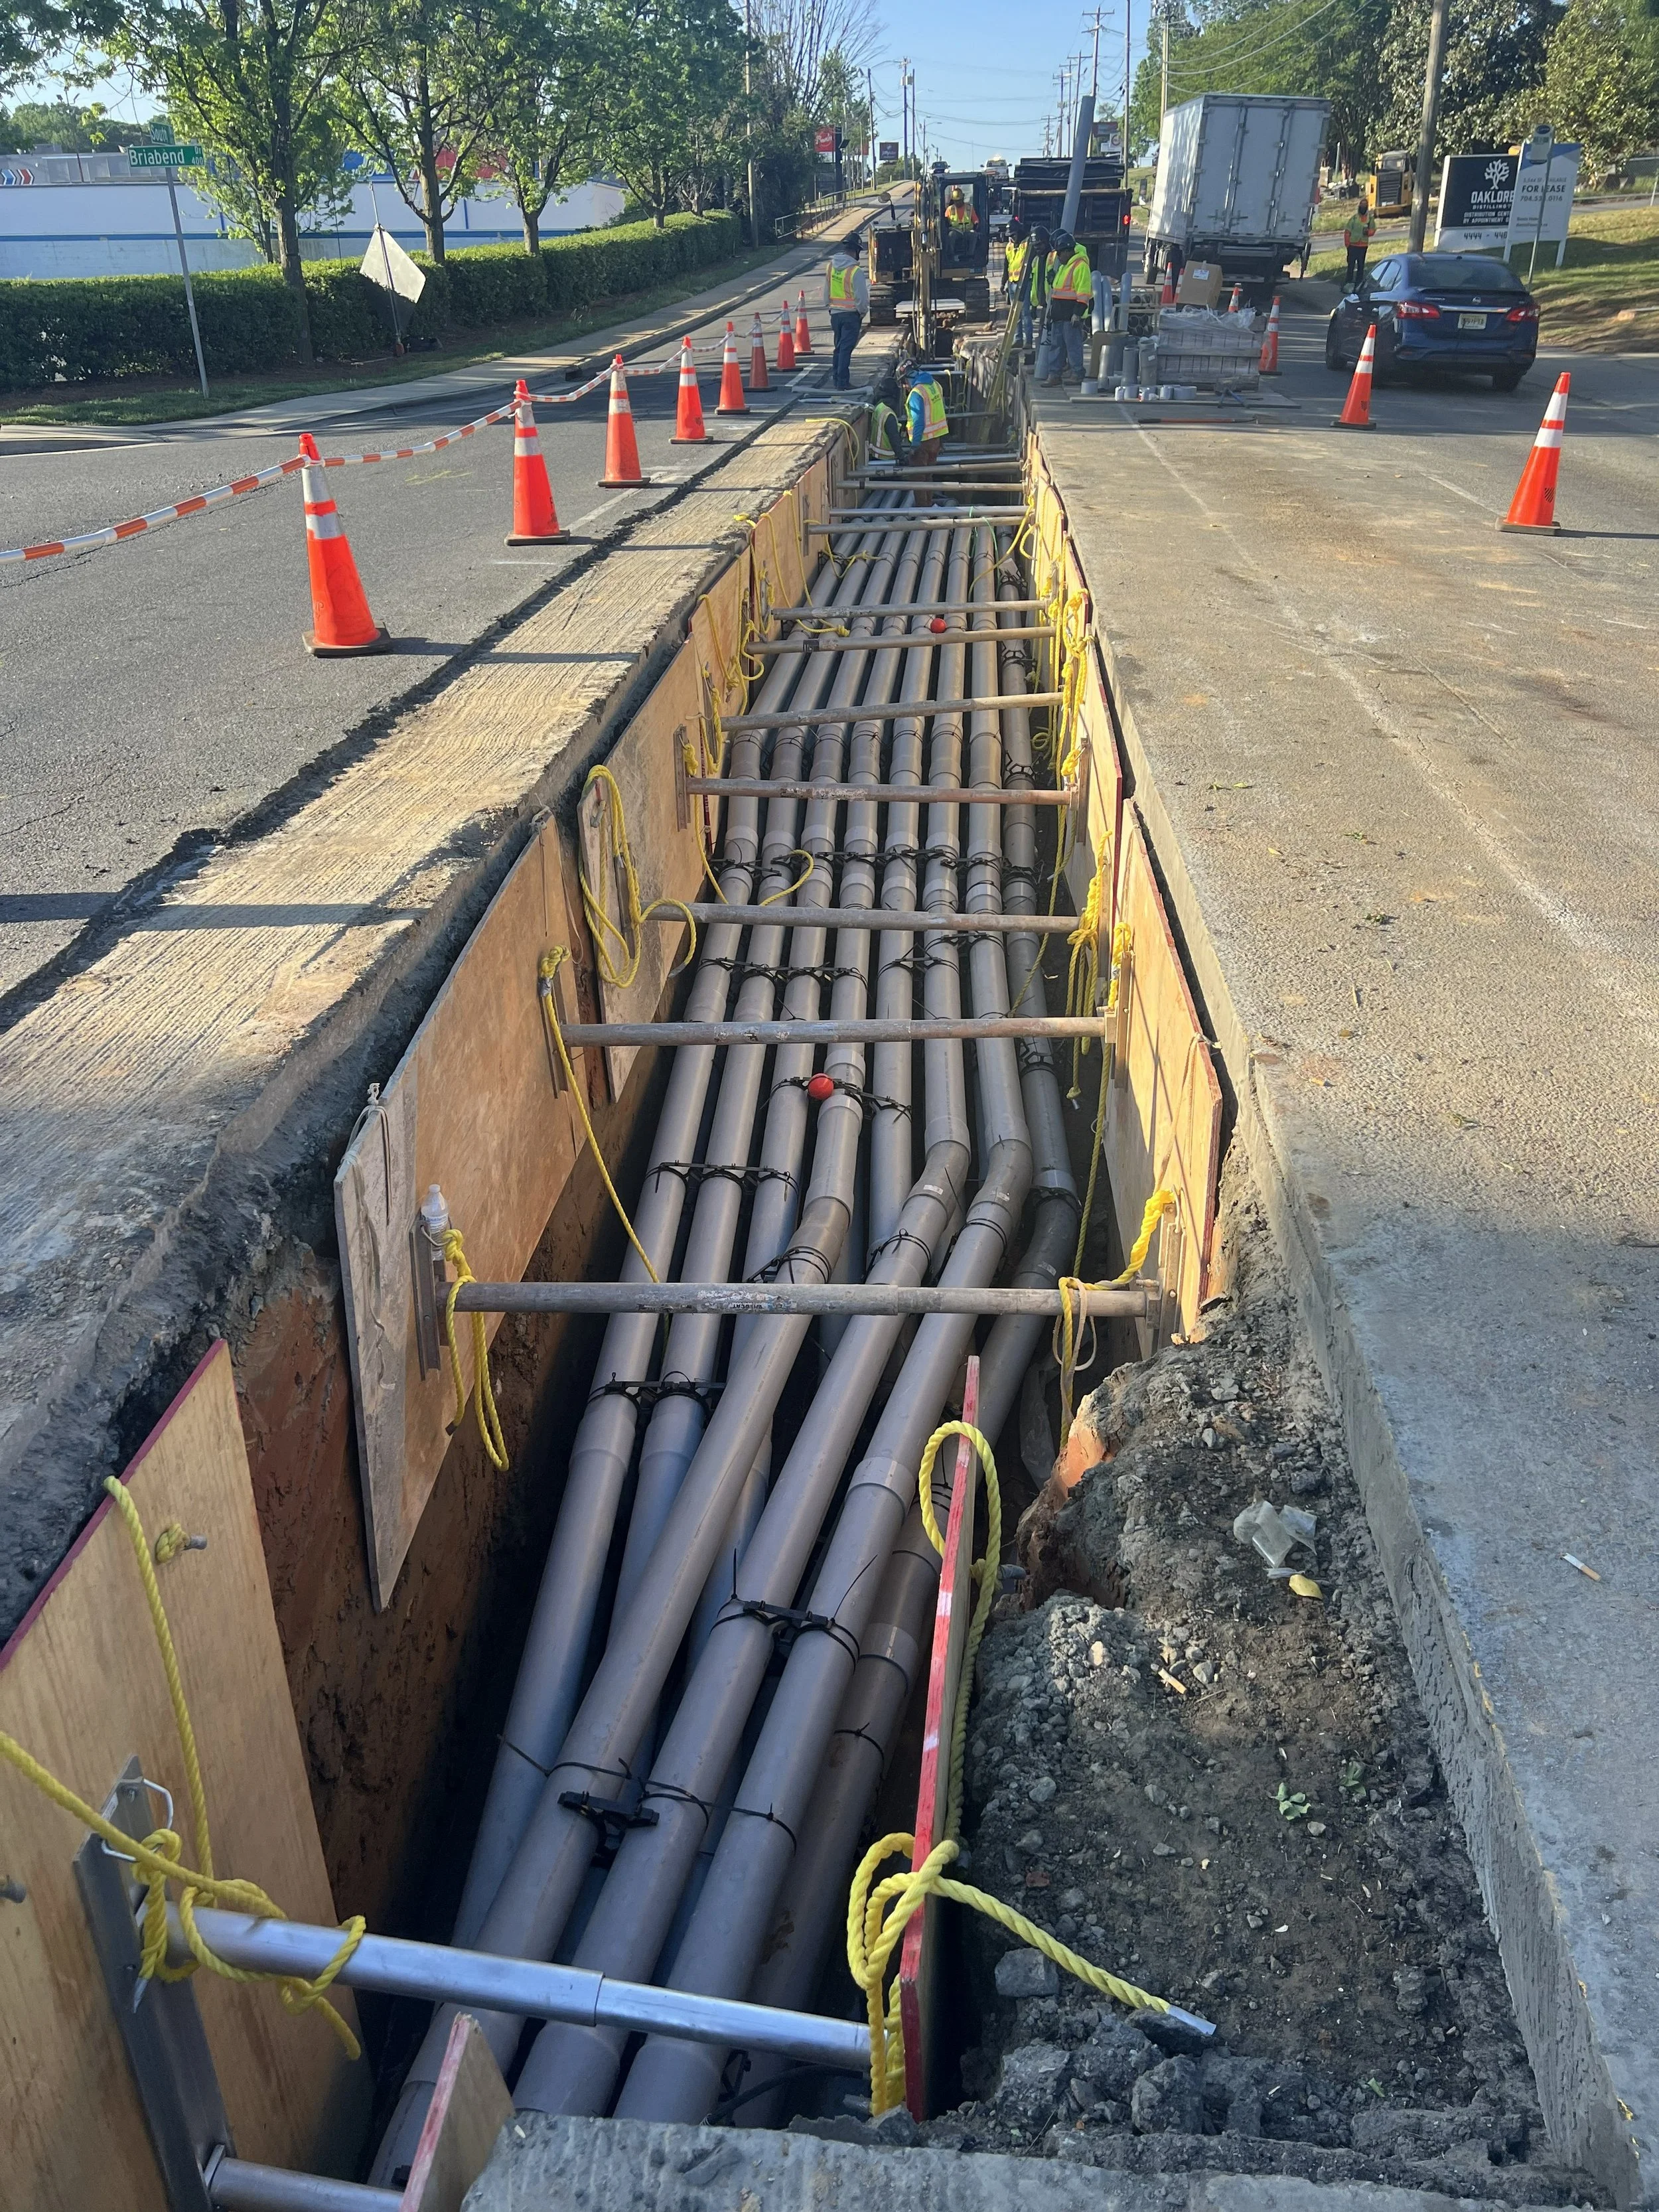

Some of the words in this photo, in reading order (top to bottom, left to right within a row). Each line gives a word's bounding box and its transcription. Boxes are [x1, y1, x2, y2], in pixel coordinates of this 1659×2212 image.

[151, 124, 169, 143] South
[129, 149, 185, 165] Briabend
[194, 145, 202, 155] Dr
[191, 157, 204, 165] 400
[1471, 190, 1514, 204] OAKLORE
